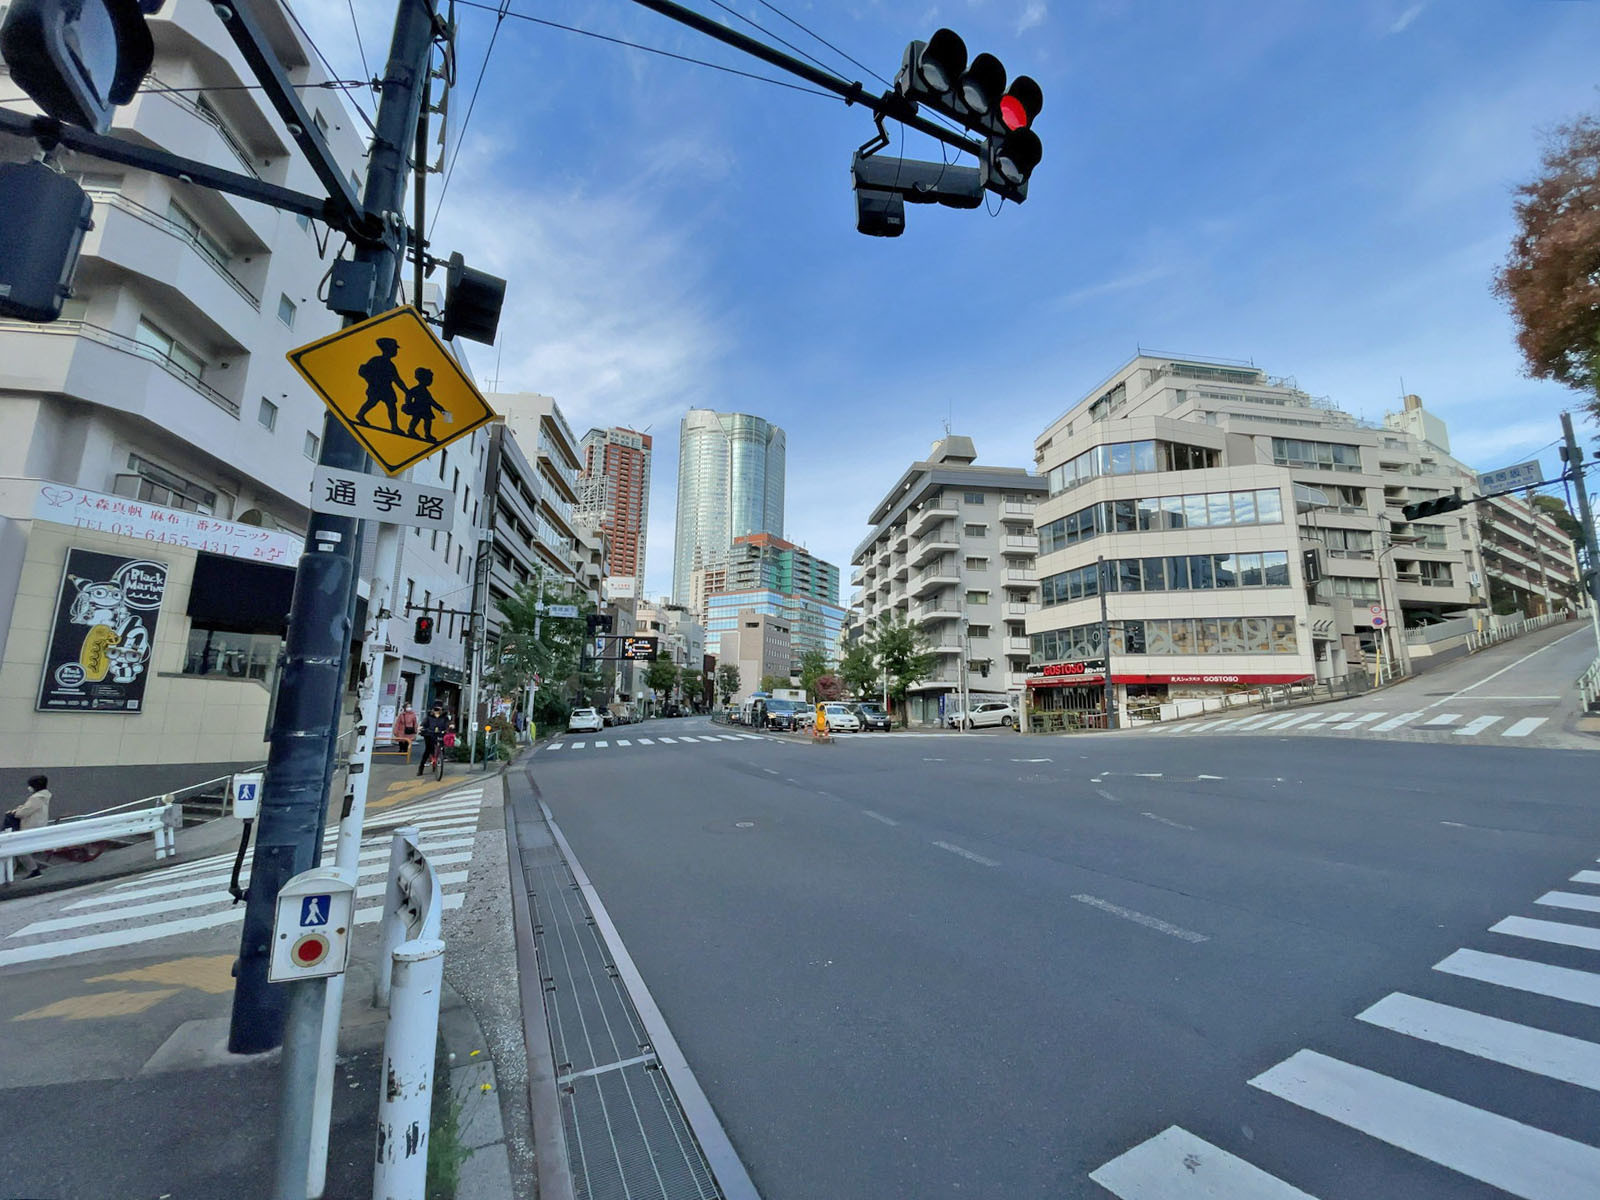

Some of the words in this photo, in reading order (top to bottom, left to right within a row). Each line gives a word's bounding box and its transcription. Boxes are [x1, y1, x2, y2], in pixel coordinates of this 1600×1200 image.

[325, 478, 444, 520] 通学路
[76, 493, 143, 518] 大森真帆
[150, 510, 271, 542] 麻布十番クリニック
[111, 522, 240, 557] 03-6455-4317
[131, 568, 163, 584] Black
[1044, 663, 1083, 676] GOSTOSO
